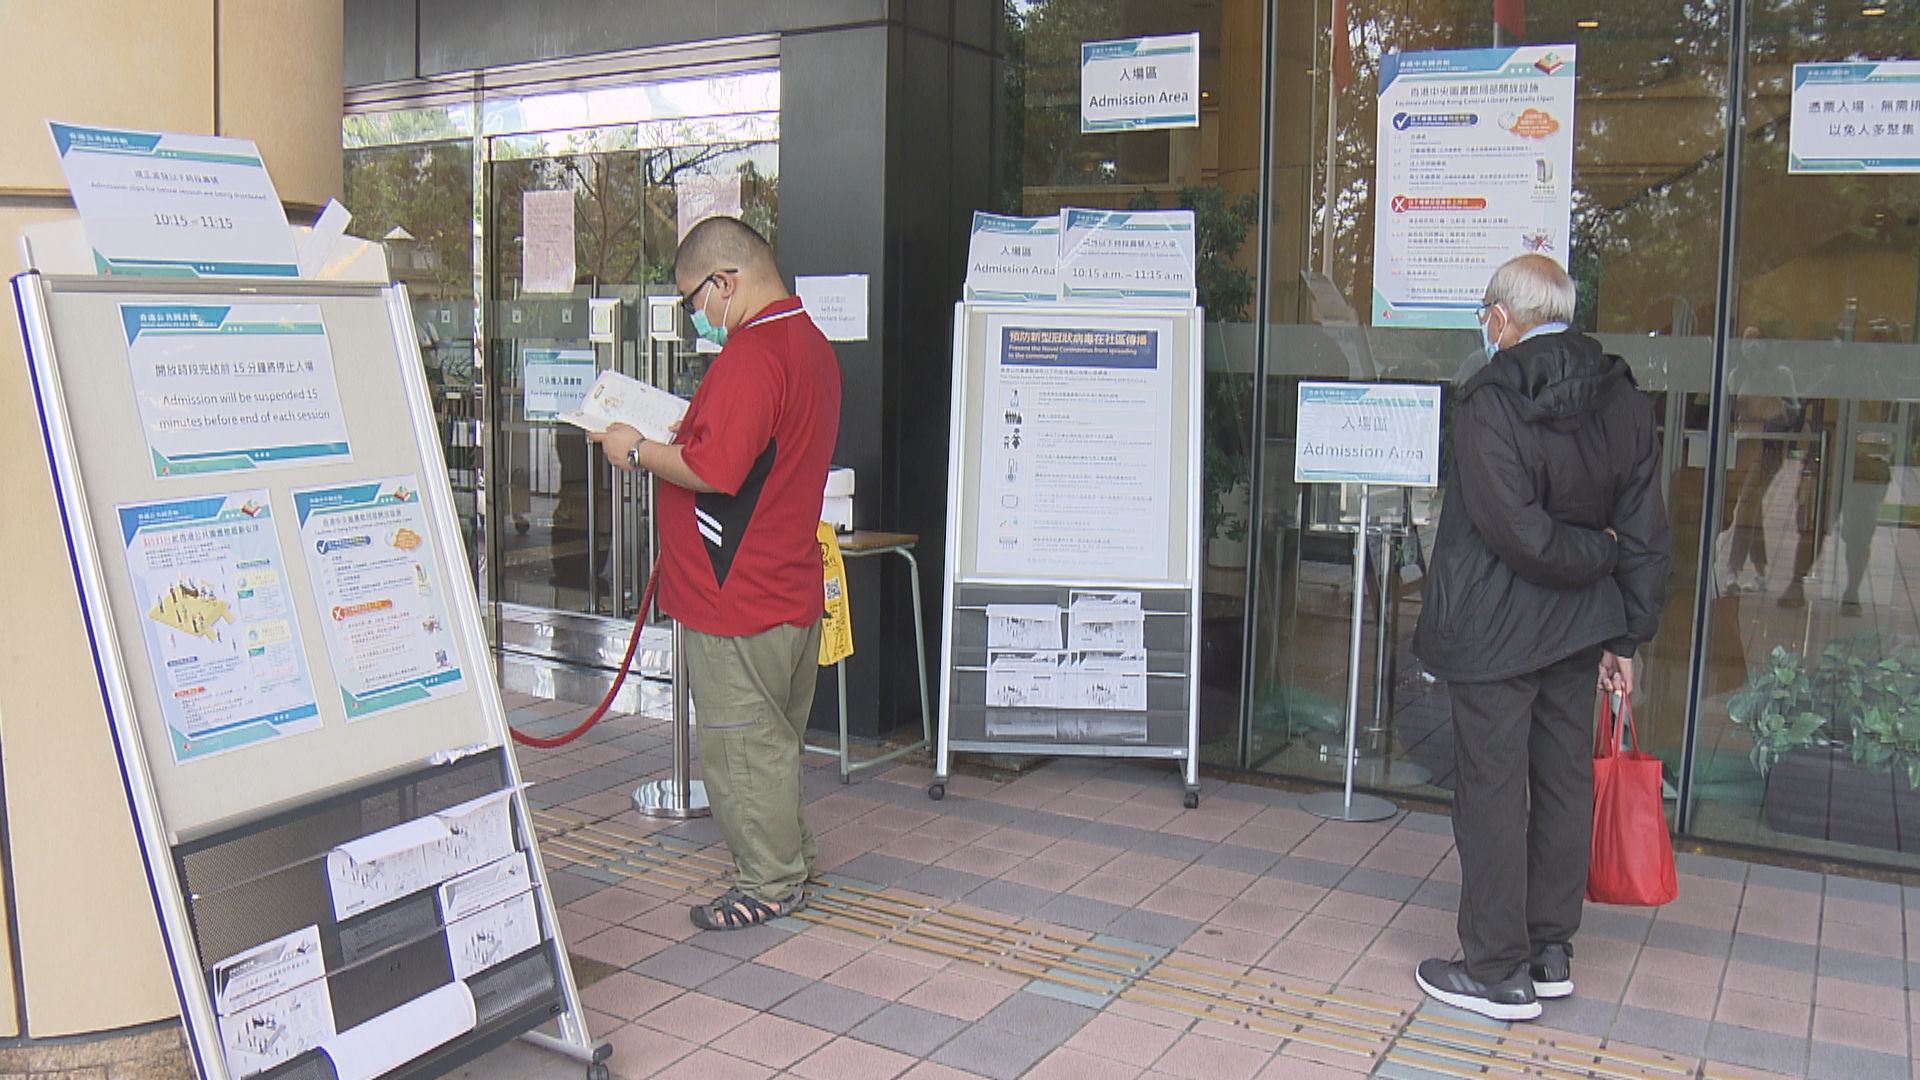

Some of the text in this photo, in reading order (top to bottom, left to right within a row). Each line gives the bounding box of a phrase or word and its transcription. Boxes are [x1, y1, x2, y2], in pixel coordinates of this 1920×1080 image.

[1120, 65, 1157, 81] 入場區
[1089, 91, 1189, 108] Admission Area
[155, 213, 188, 227] 10:15
[201, 215, 233, 230] 11:15
[1000, 245, 1032, 258] 入場區
[974, 262, 1056, 276] Admission Area
[1072, 267, 1099, 278] 10:15
[1135, 269, 1161, 279] 11:15
[1009, 330, 1148, 346] 預防新型冠狀病毒在社區傳播
[234, 363, 245, 374] 15
[163, 388, 319, 406] Admission will be suspended 15
[159, 407, 331, 430] minutes before end of each session
[1342, 415, 1388, 432] 入場區
[1303, 441, 1424, 461] Admission Area
